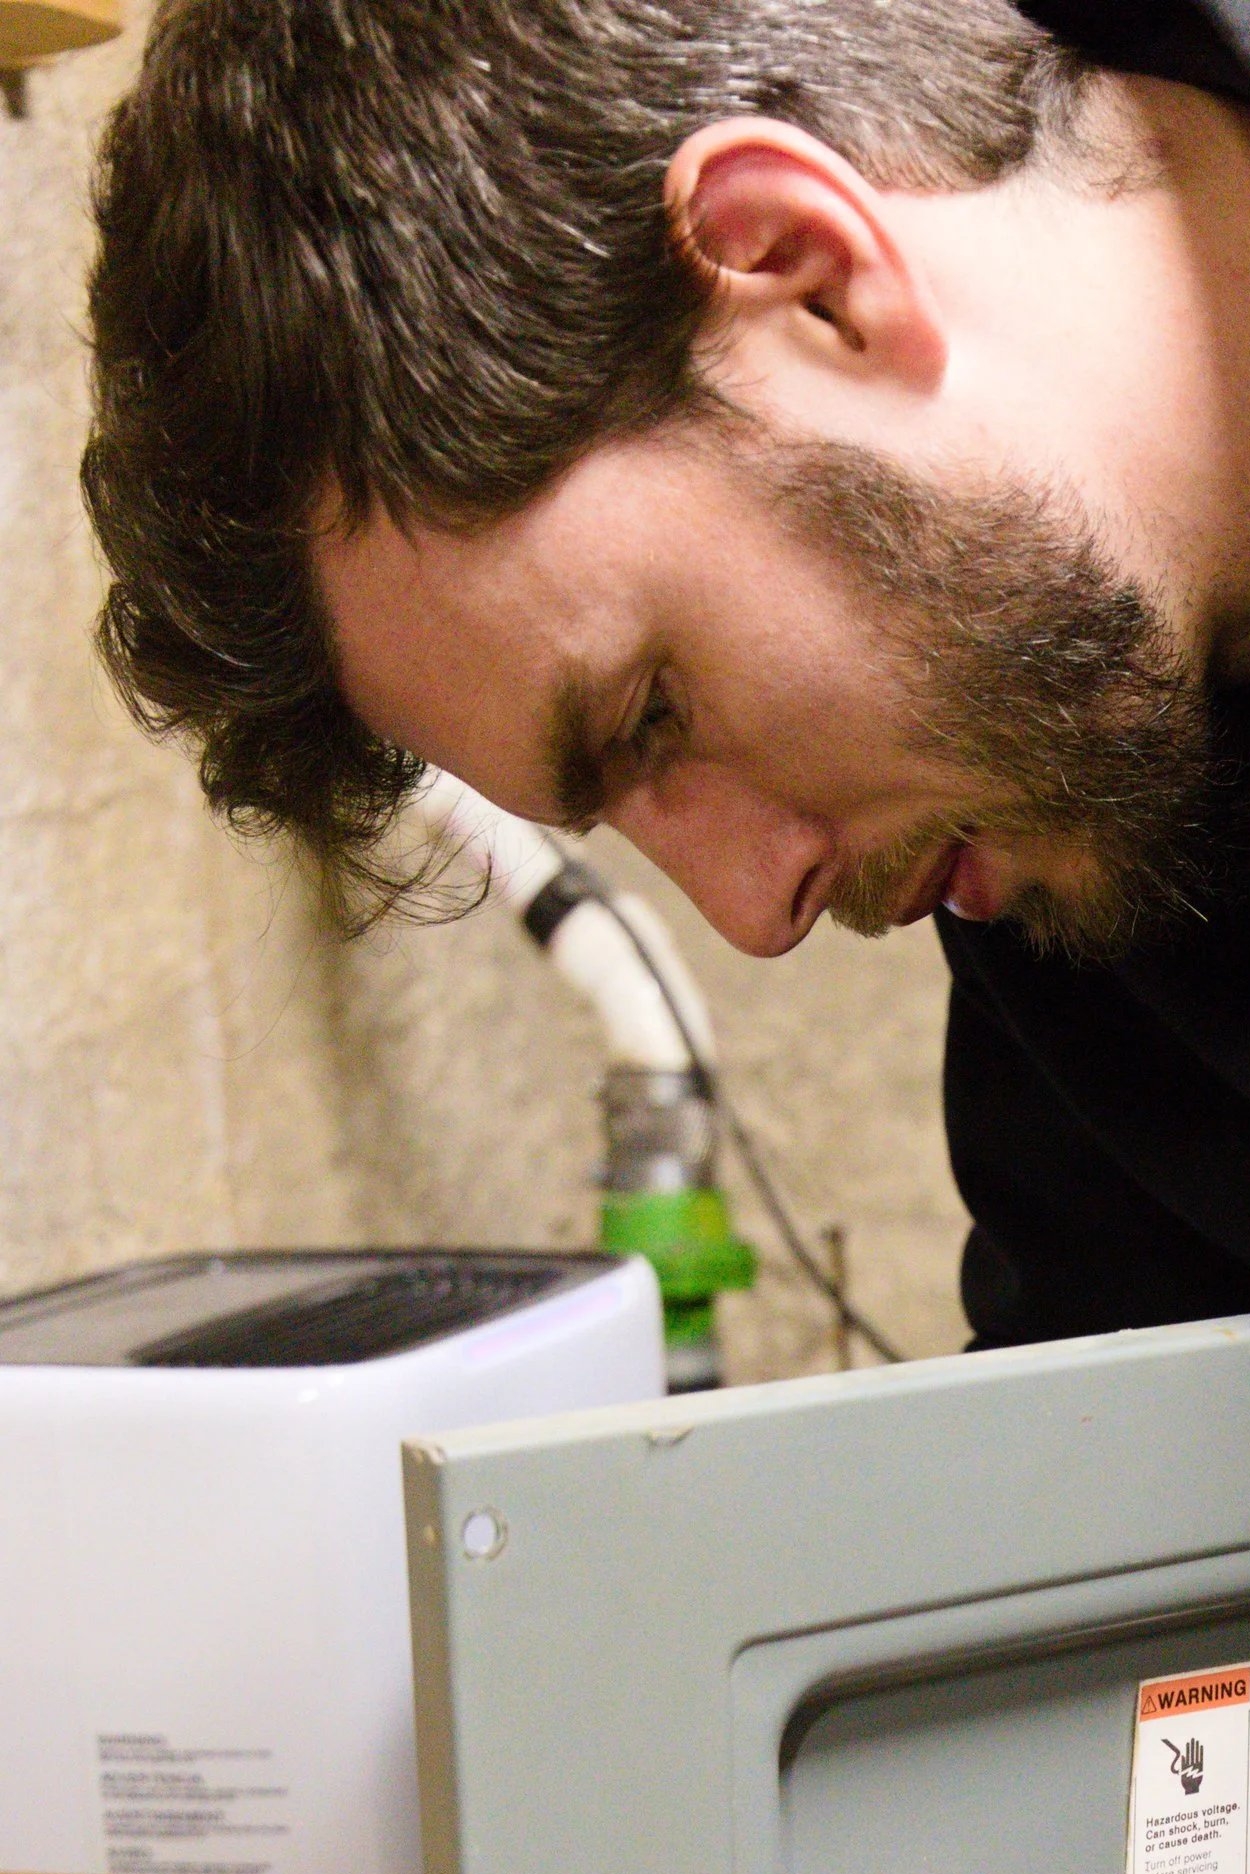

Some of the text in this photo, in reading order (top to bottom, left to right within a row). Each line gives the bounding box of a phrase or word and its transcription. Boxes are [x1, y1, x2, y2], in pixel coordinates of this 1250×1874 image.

[1157, 1679, 1247, 1710] WARNING
[1146, 1801, 1241, 1829] Hazardous voltage.
[1145, 1828, 1166, 1841] Can
[1168, 1823, 1201, 1837] shock,
[1145, 1830, 1222, 1854] or cause death.
[1144, 1849, 1212, 1874] Turn off power
